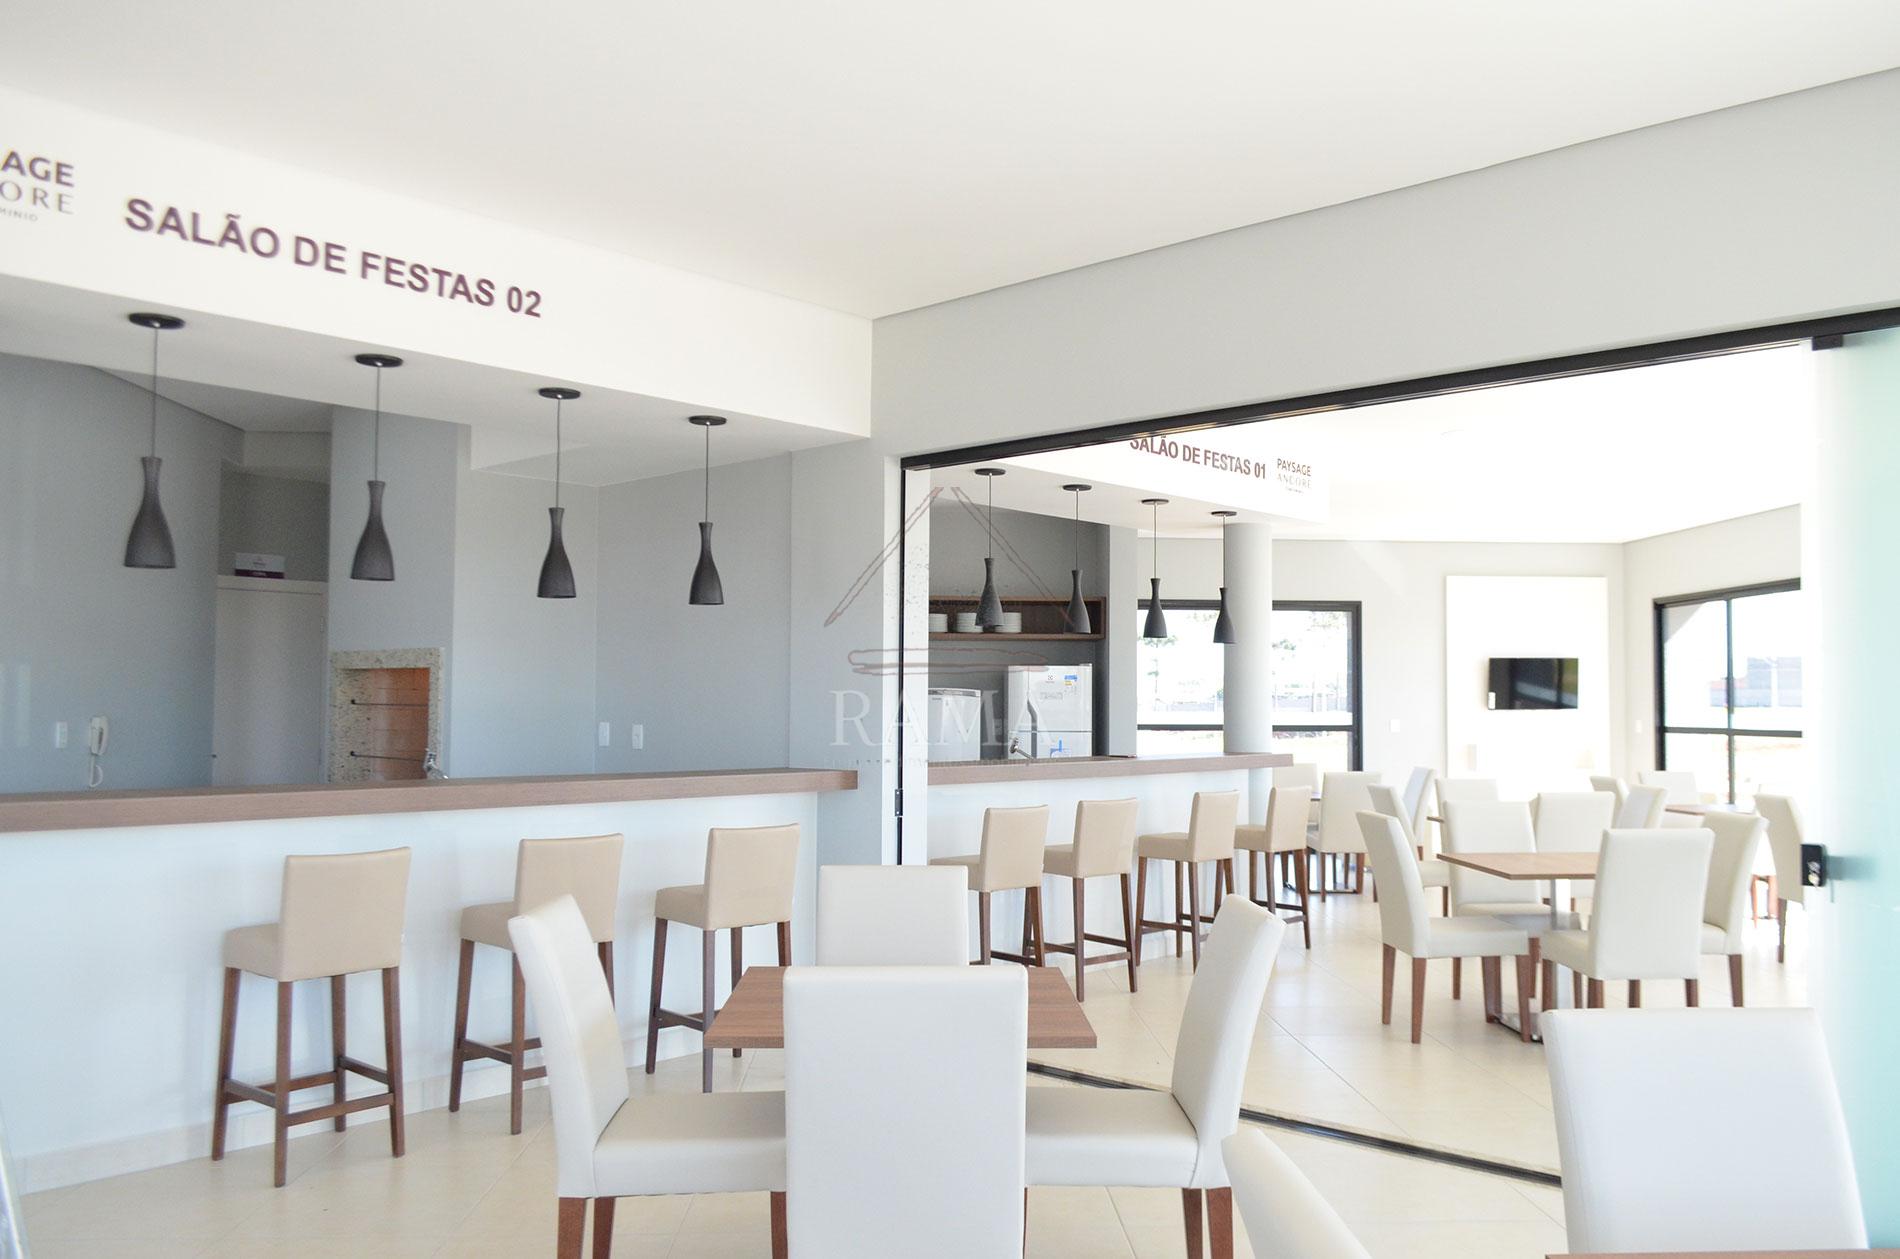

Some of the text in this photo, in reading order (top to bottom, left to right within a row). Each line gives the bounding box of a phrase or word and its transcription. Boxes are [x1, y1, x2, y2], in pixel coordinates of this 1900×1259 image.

[1, 150, 75, 188] AGE
[125, 198, 543, 318] SALÃO DE FESTAS 02
[1130, 436, 1266, 480] SALÃO DE FESTAS 01
[1277, 458, 1311, 477] PAYSAGE
